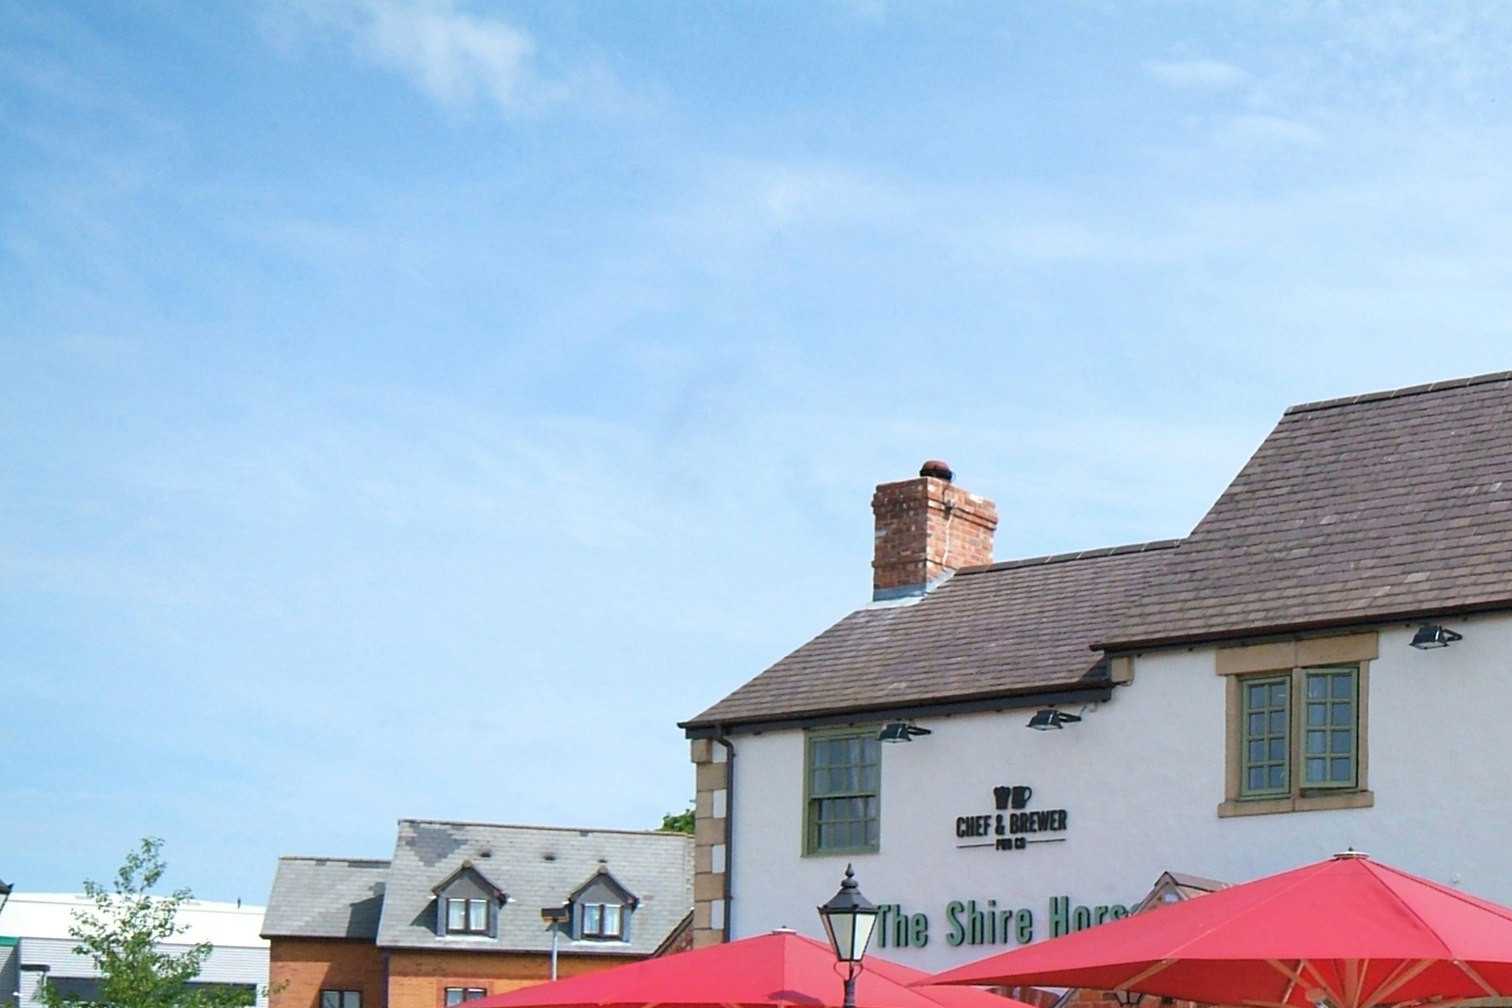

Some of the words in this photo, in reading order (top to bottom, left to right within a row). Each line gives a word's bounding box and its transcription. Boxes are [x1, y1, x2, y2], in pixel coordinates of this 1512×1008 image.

[956, 814, 993, 838] CHEF
[995, 813, 1006, 836] &
[1009, 808, 1068, 834] BREWER
[1014, 837, 1026, 850] CO
[876, 904, 929, 948] The
[946, 900, 1033, 947] Shire
[1049, 895, 1144, 940] Hor
